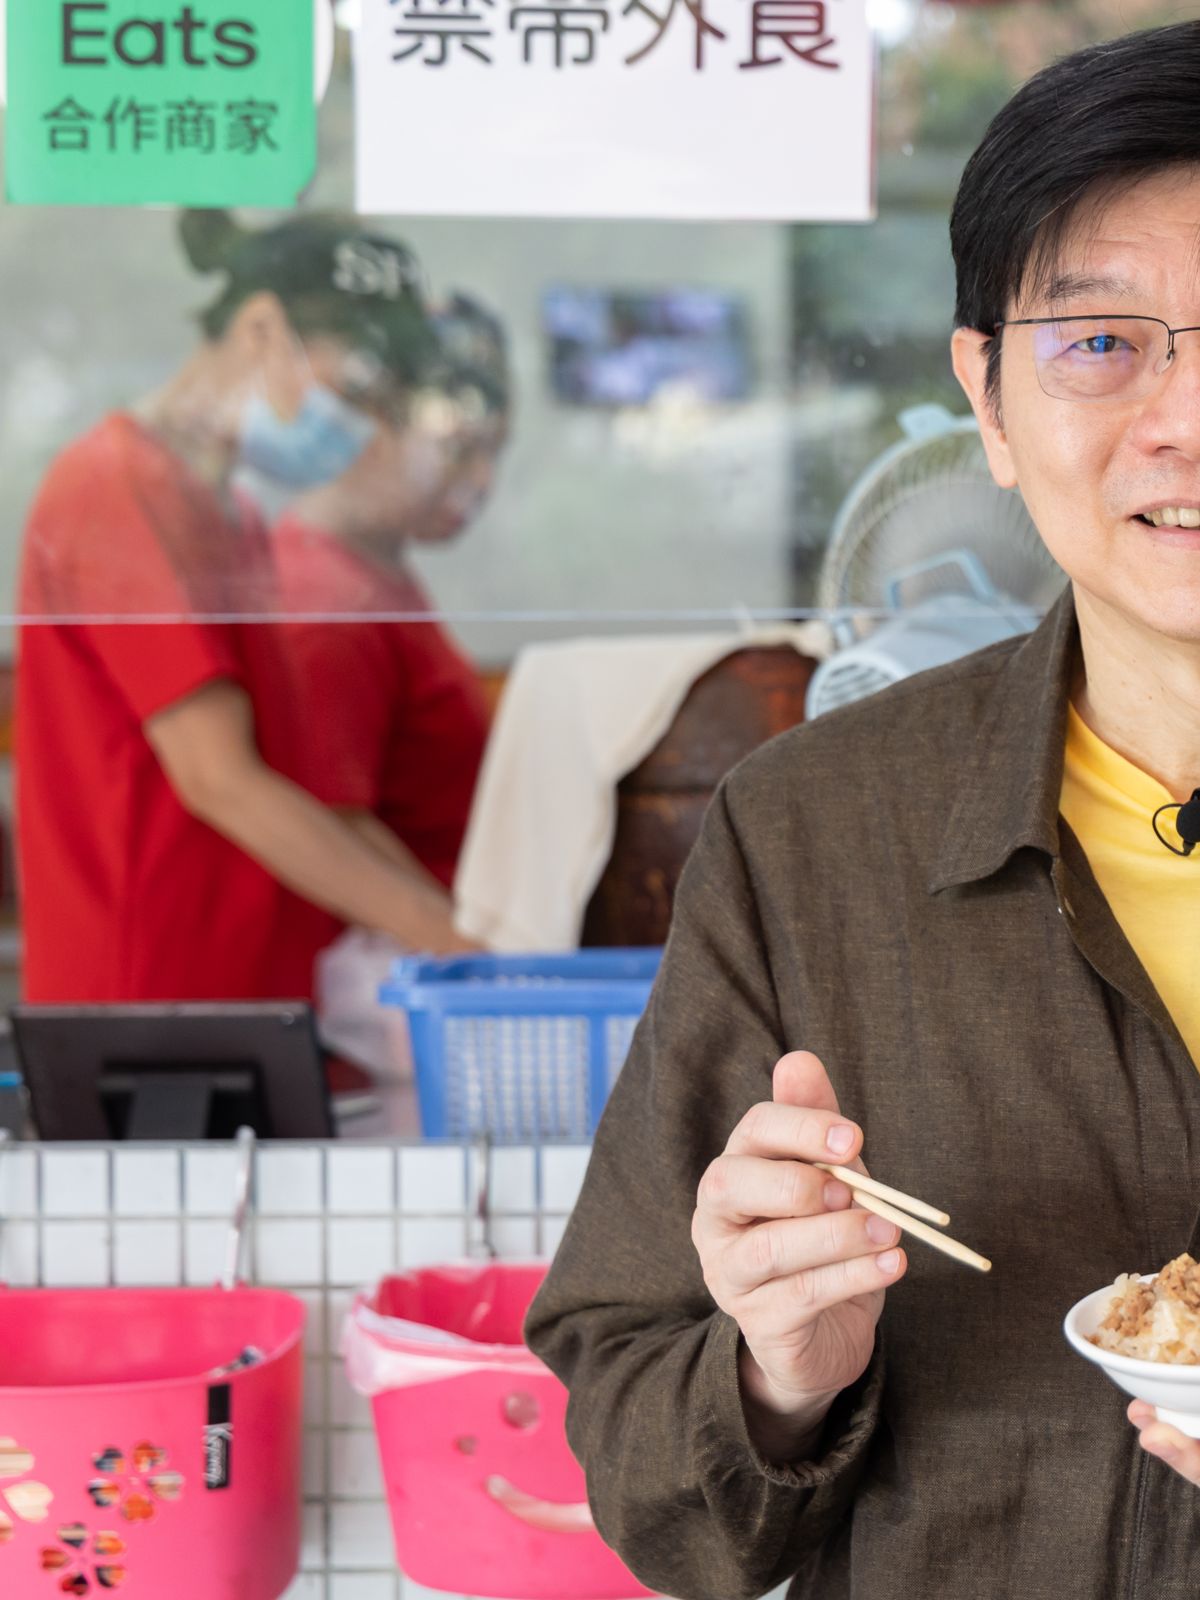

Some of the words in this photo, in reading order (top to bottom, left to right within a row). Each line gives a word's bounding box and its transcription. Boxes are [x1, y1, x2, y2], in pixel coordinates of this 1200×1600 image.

[60, 2, 259, 67] Eats
[391, 0, 841, 70] 禁帶外食
[42, 96, 280, 154] 合作商家
